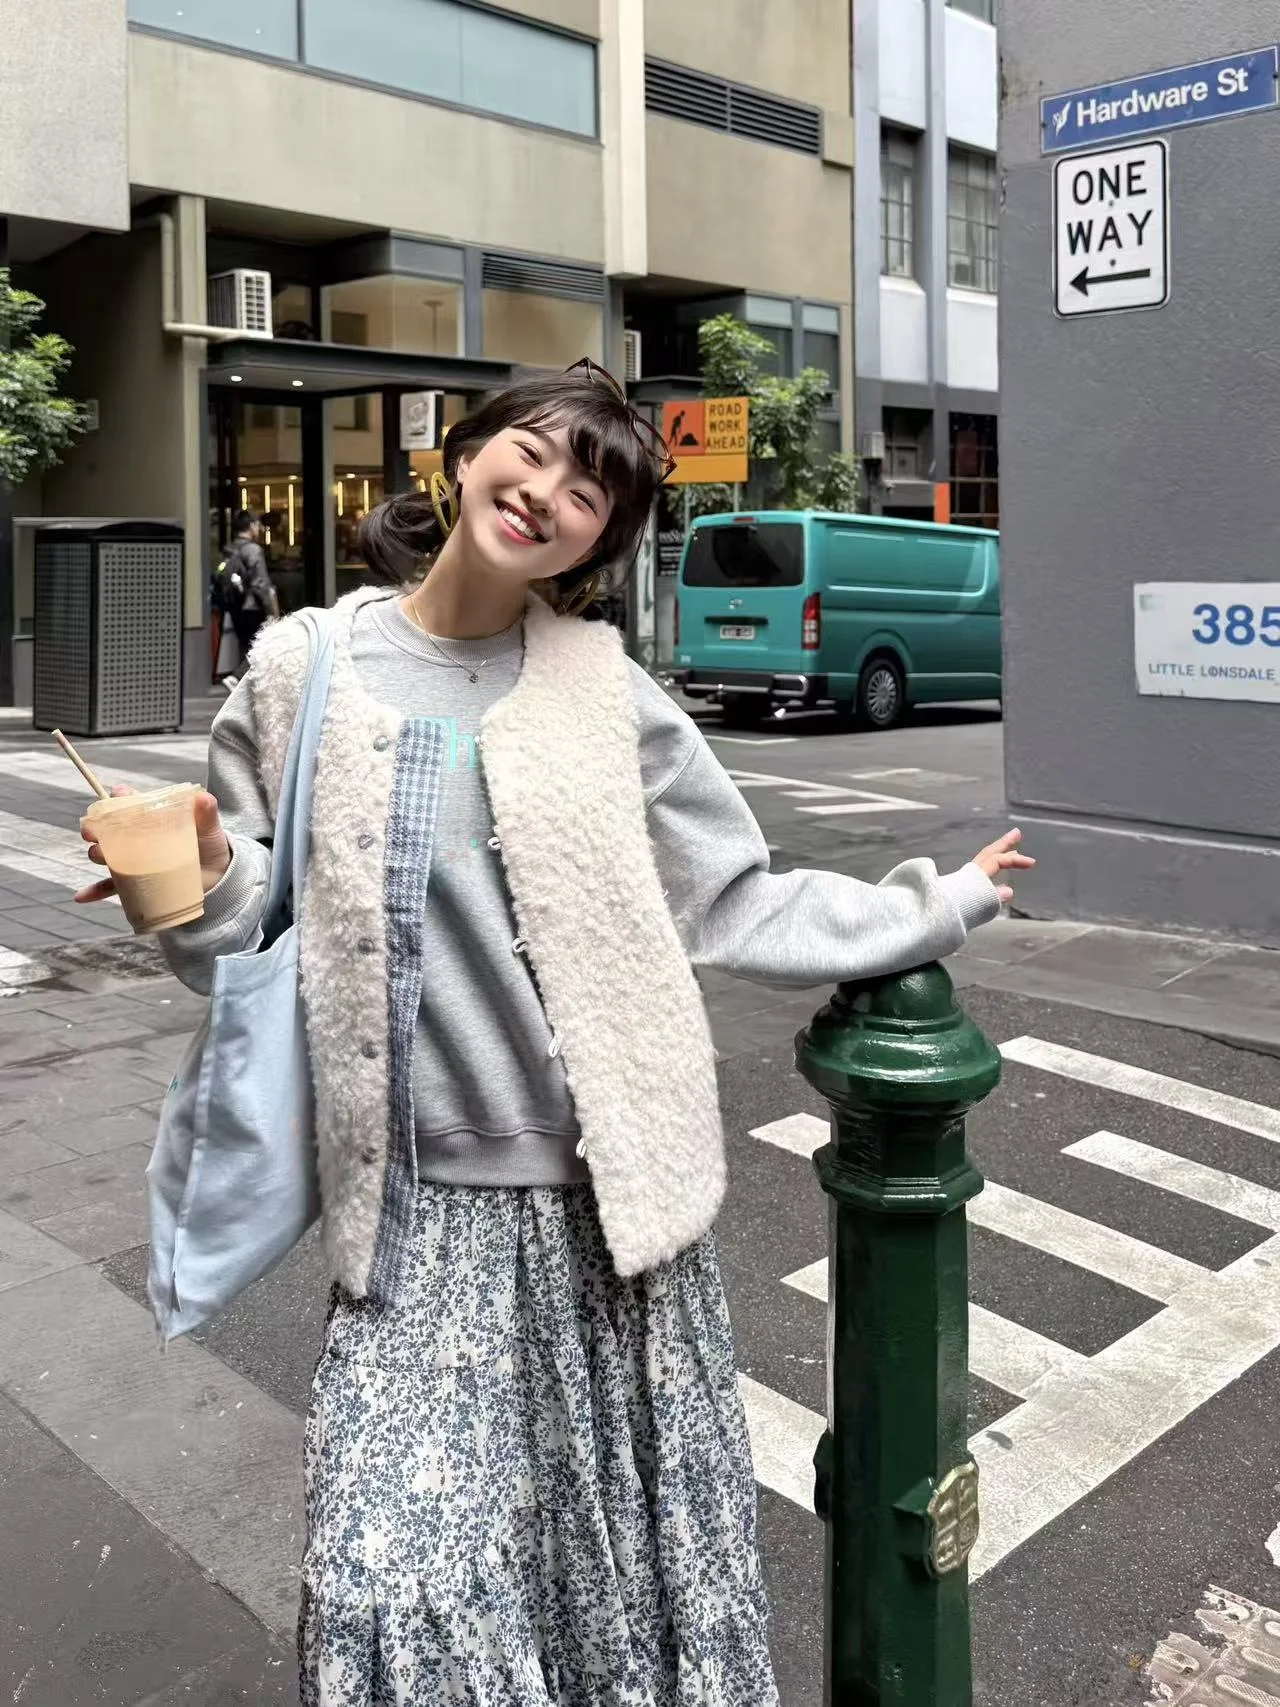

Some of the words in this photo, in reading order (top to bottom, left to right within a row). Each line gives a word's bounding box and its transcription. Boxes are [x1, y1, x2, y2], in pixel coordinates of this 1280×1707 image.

[1076, 81, 1208, 127] Hardware
[1217, 67, 1249, 96] St
[1073, 160, 1147, 205] ONE
[1067, 210, 1153, 256] WAY
[709, 403, 742, 416] ROAD
[709, 420, 741, 433] WORK
[706, 436, 745, 449] AHEAD
[1192, 603, 1280, 647] 385
[1148, 663, 1195, 676] LITTLE
[1200, 666, 1276, 681] LONSDALE
